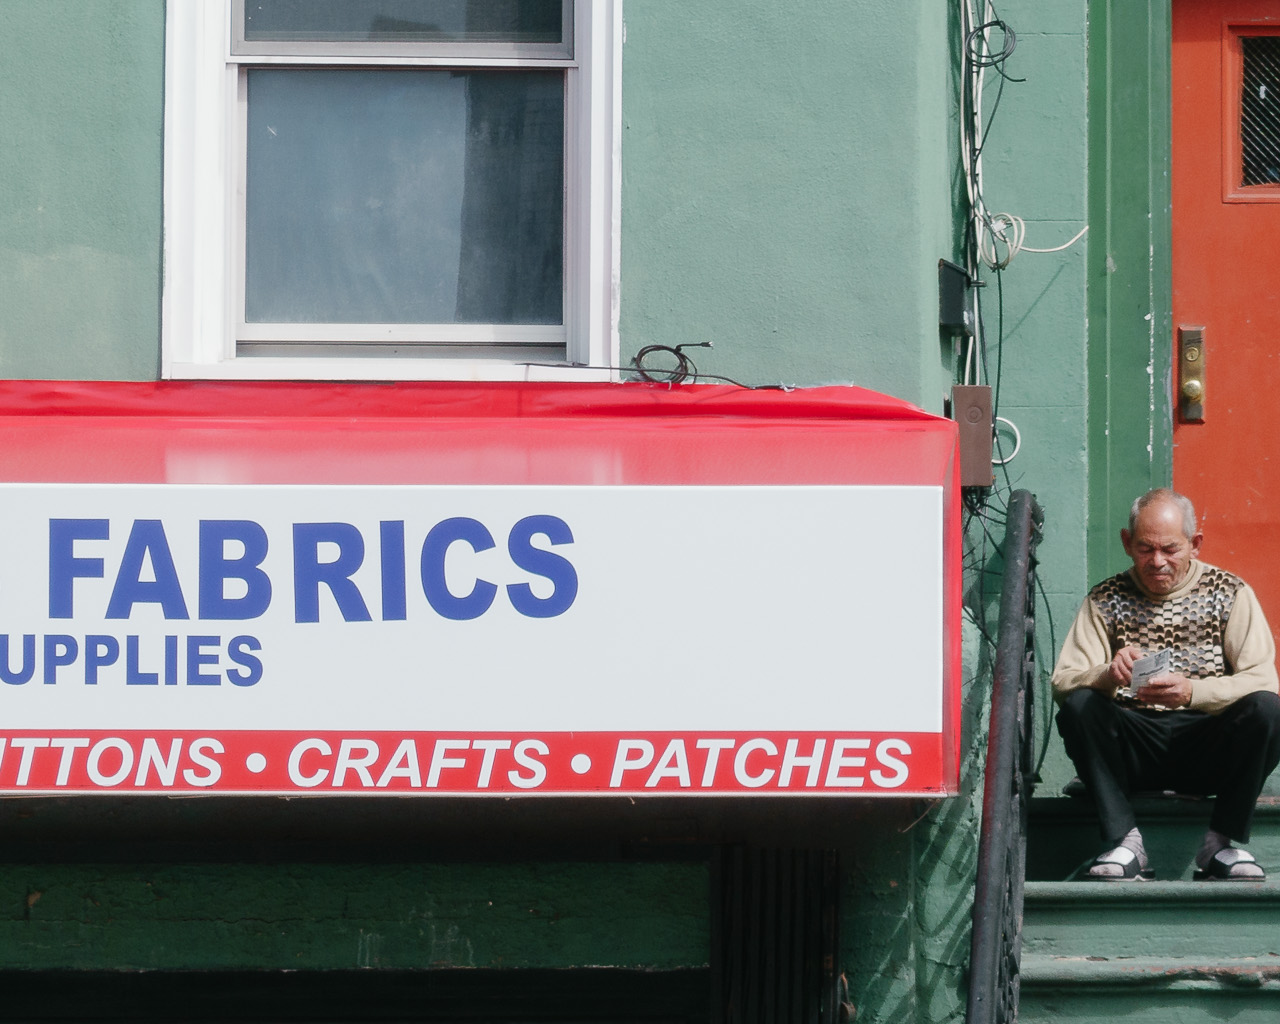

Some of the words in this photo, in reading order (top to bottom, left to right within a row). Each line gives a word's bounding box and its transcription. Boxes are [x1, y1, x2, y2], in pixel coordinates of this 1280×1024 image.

[49, 515, 578, 624] FABRICS
[0, 634, 263, 687] UPPLIES
[0, 737, 225, 788] TTONS
[287, 738, 550, 789] CRAFTS
[610, 738, 912, 788] PATCHES
